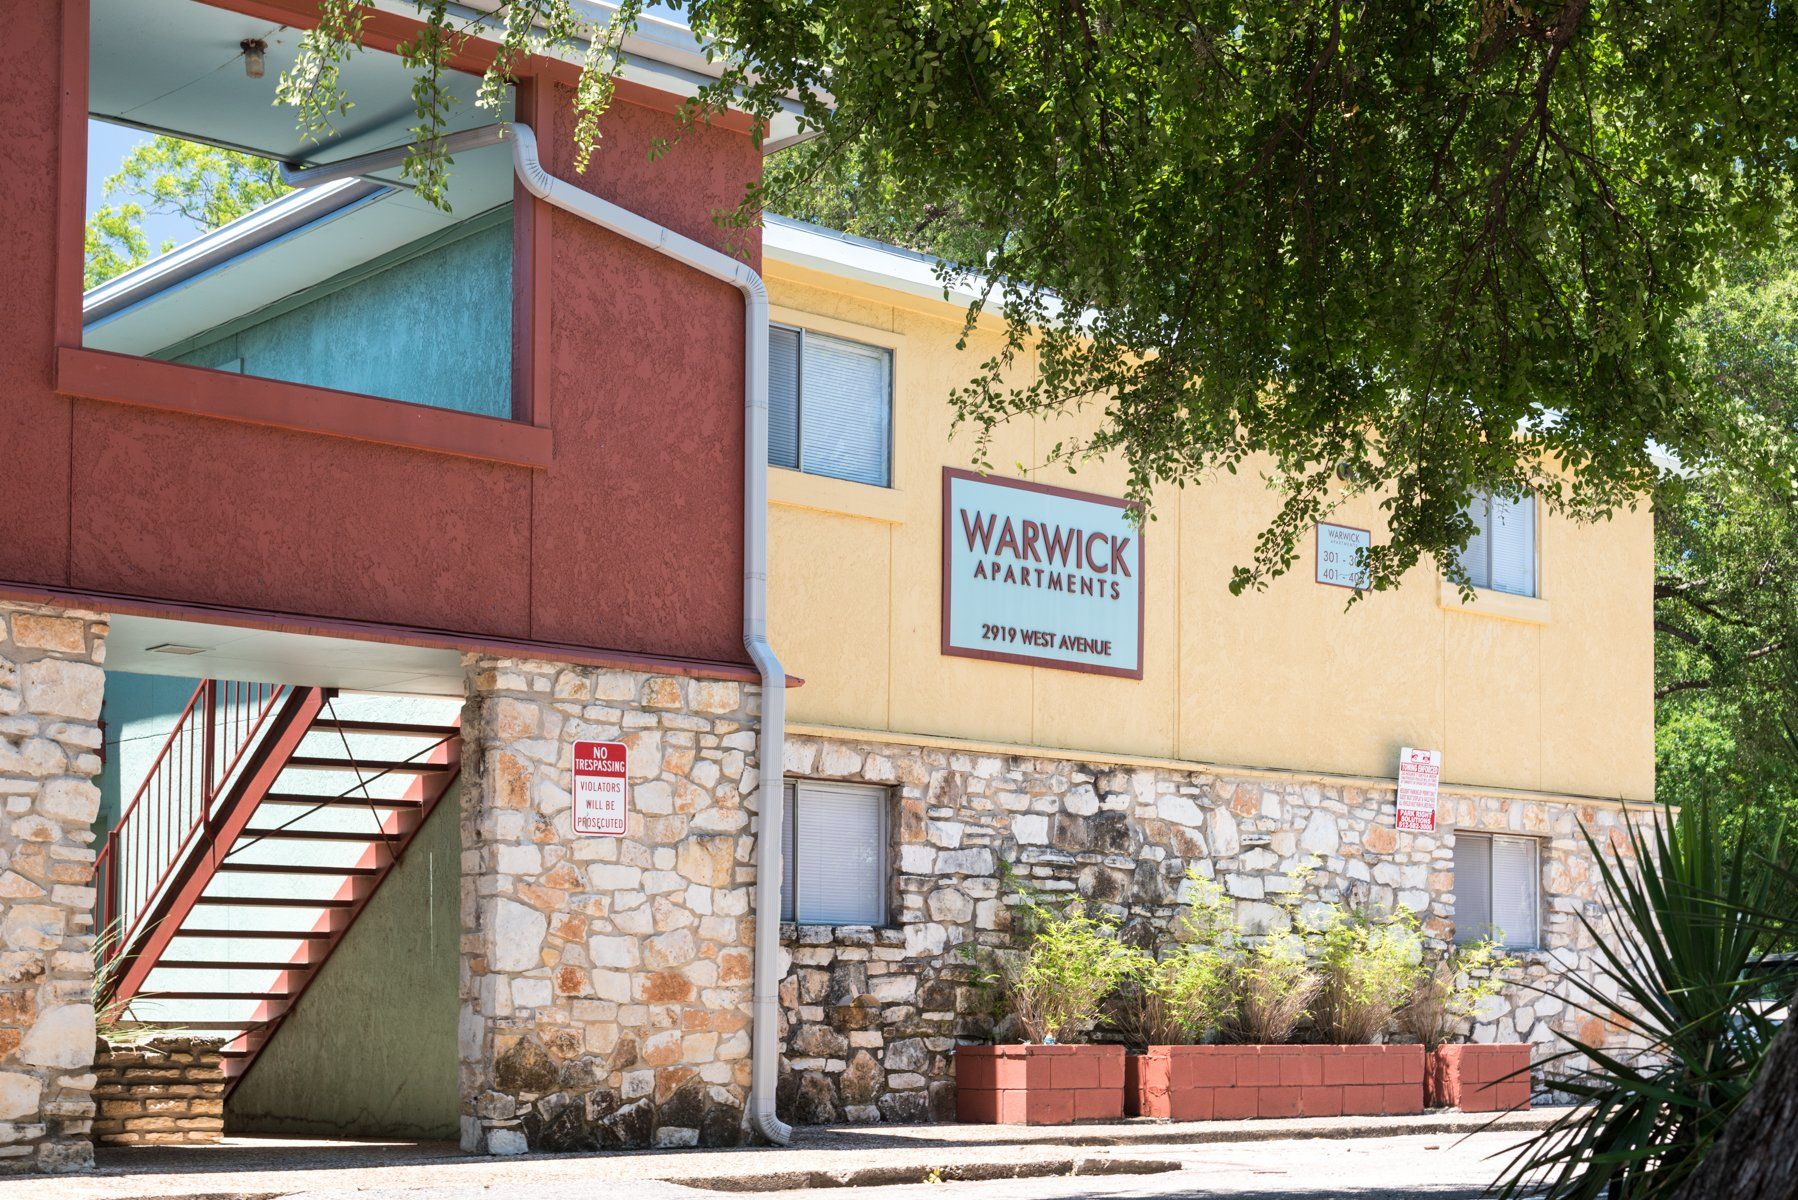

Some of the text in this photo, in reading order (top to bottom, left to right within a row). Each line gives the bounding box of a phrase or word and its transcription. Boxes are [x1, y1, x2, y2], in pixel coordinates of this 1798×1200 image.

[1328, 529, 1360, 543] WARWICK
[960, 508, 1132, 578] WARWICK
[1323, 550, 1339, 563] 301
[974, 559, 1121, 600] APARTMENTS
[1323, 568, 1338, 580] 401
[981, 623, 1112, 656] 2919 WEST AVENUE
[593, 746, 608, 759] NO
[575, 758, 625, 773] TRESPASSING
[580, 781, 621, 793] VIOLATORS
[586, 799, 615, 811] WILL BE
[577, 817, 624, 829] PROSECUTED
